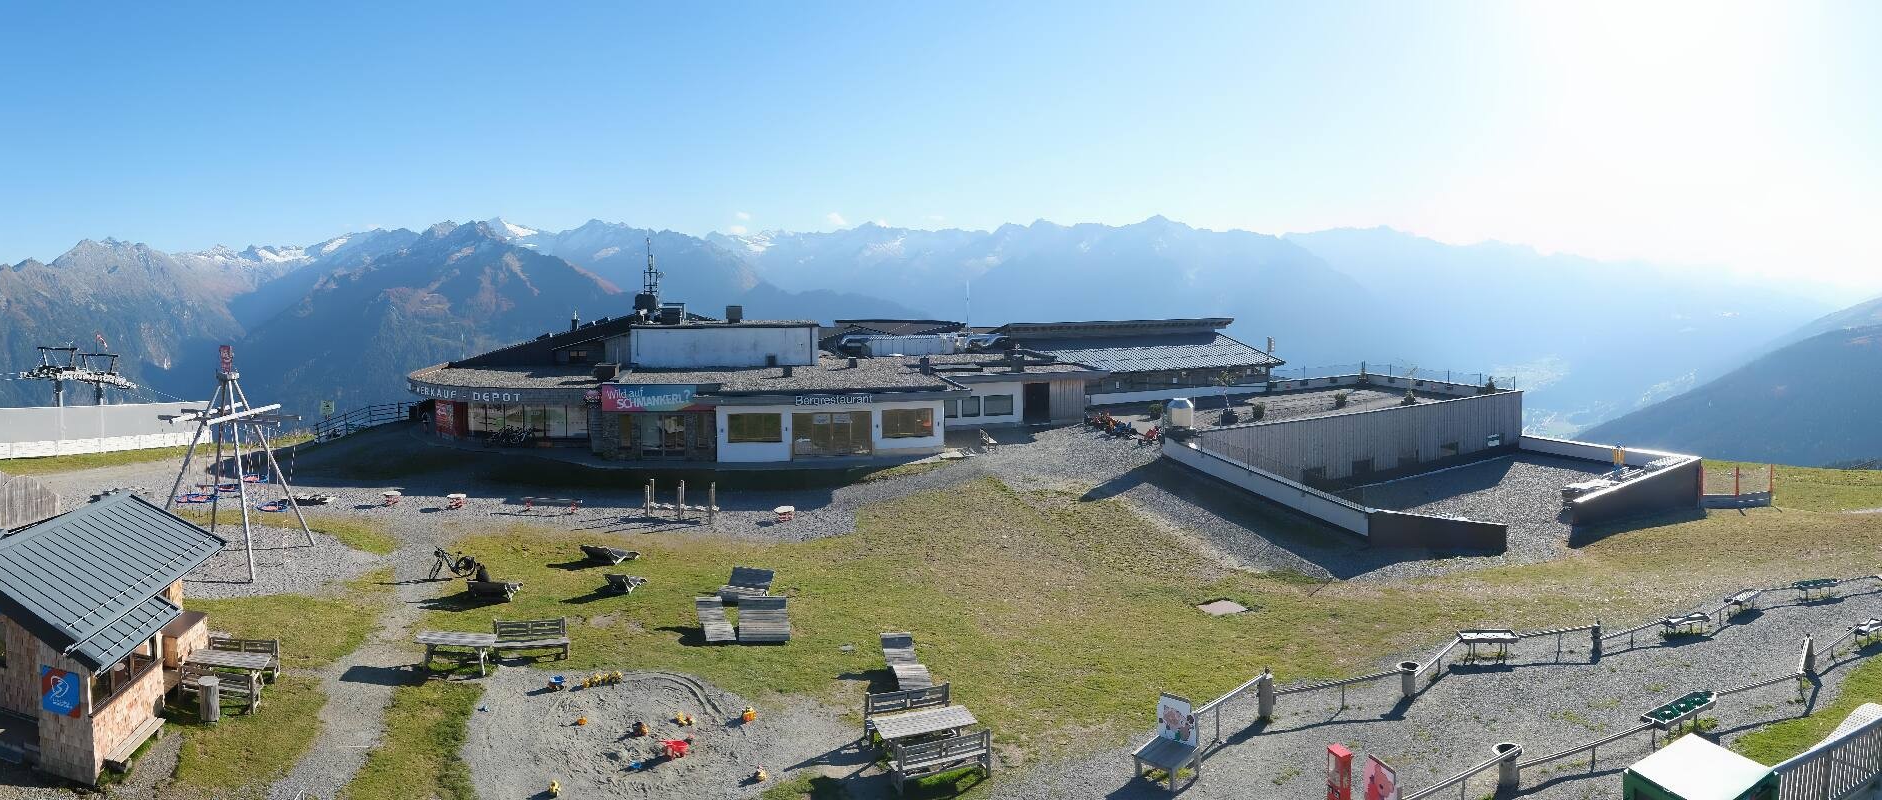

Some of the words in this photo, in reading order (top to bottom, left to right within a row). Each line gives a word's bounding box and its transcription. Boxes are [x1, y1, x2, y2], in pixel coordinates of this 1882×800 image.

[473, 392, 521, 402] DEPOT
[606, 388, 626, 399] Wild
[629, 386, 644, 397] auf
[616, 389, 691, 409] SCHMANKERL?
[795, 394, 873, 406] Bergrestaurant
